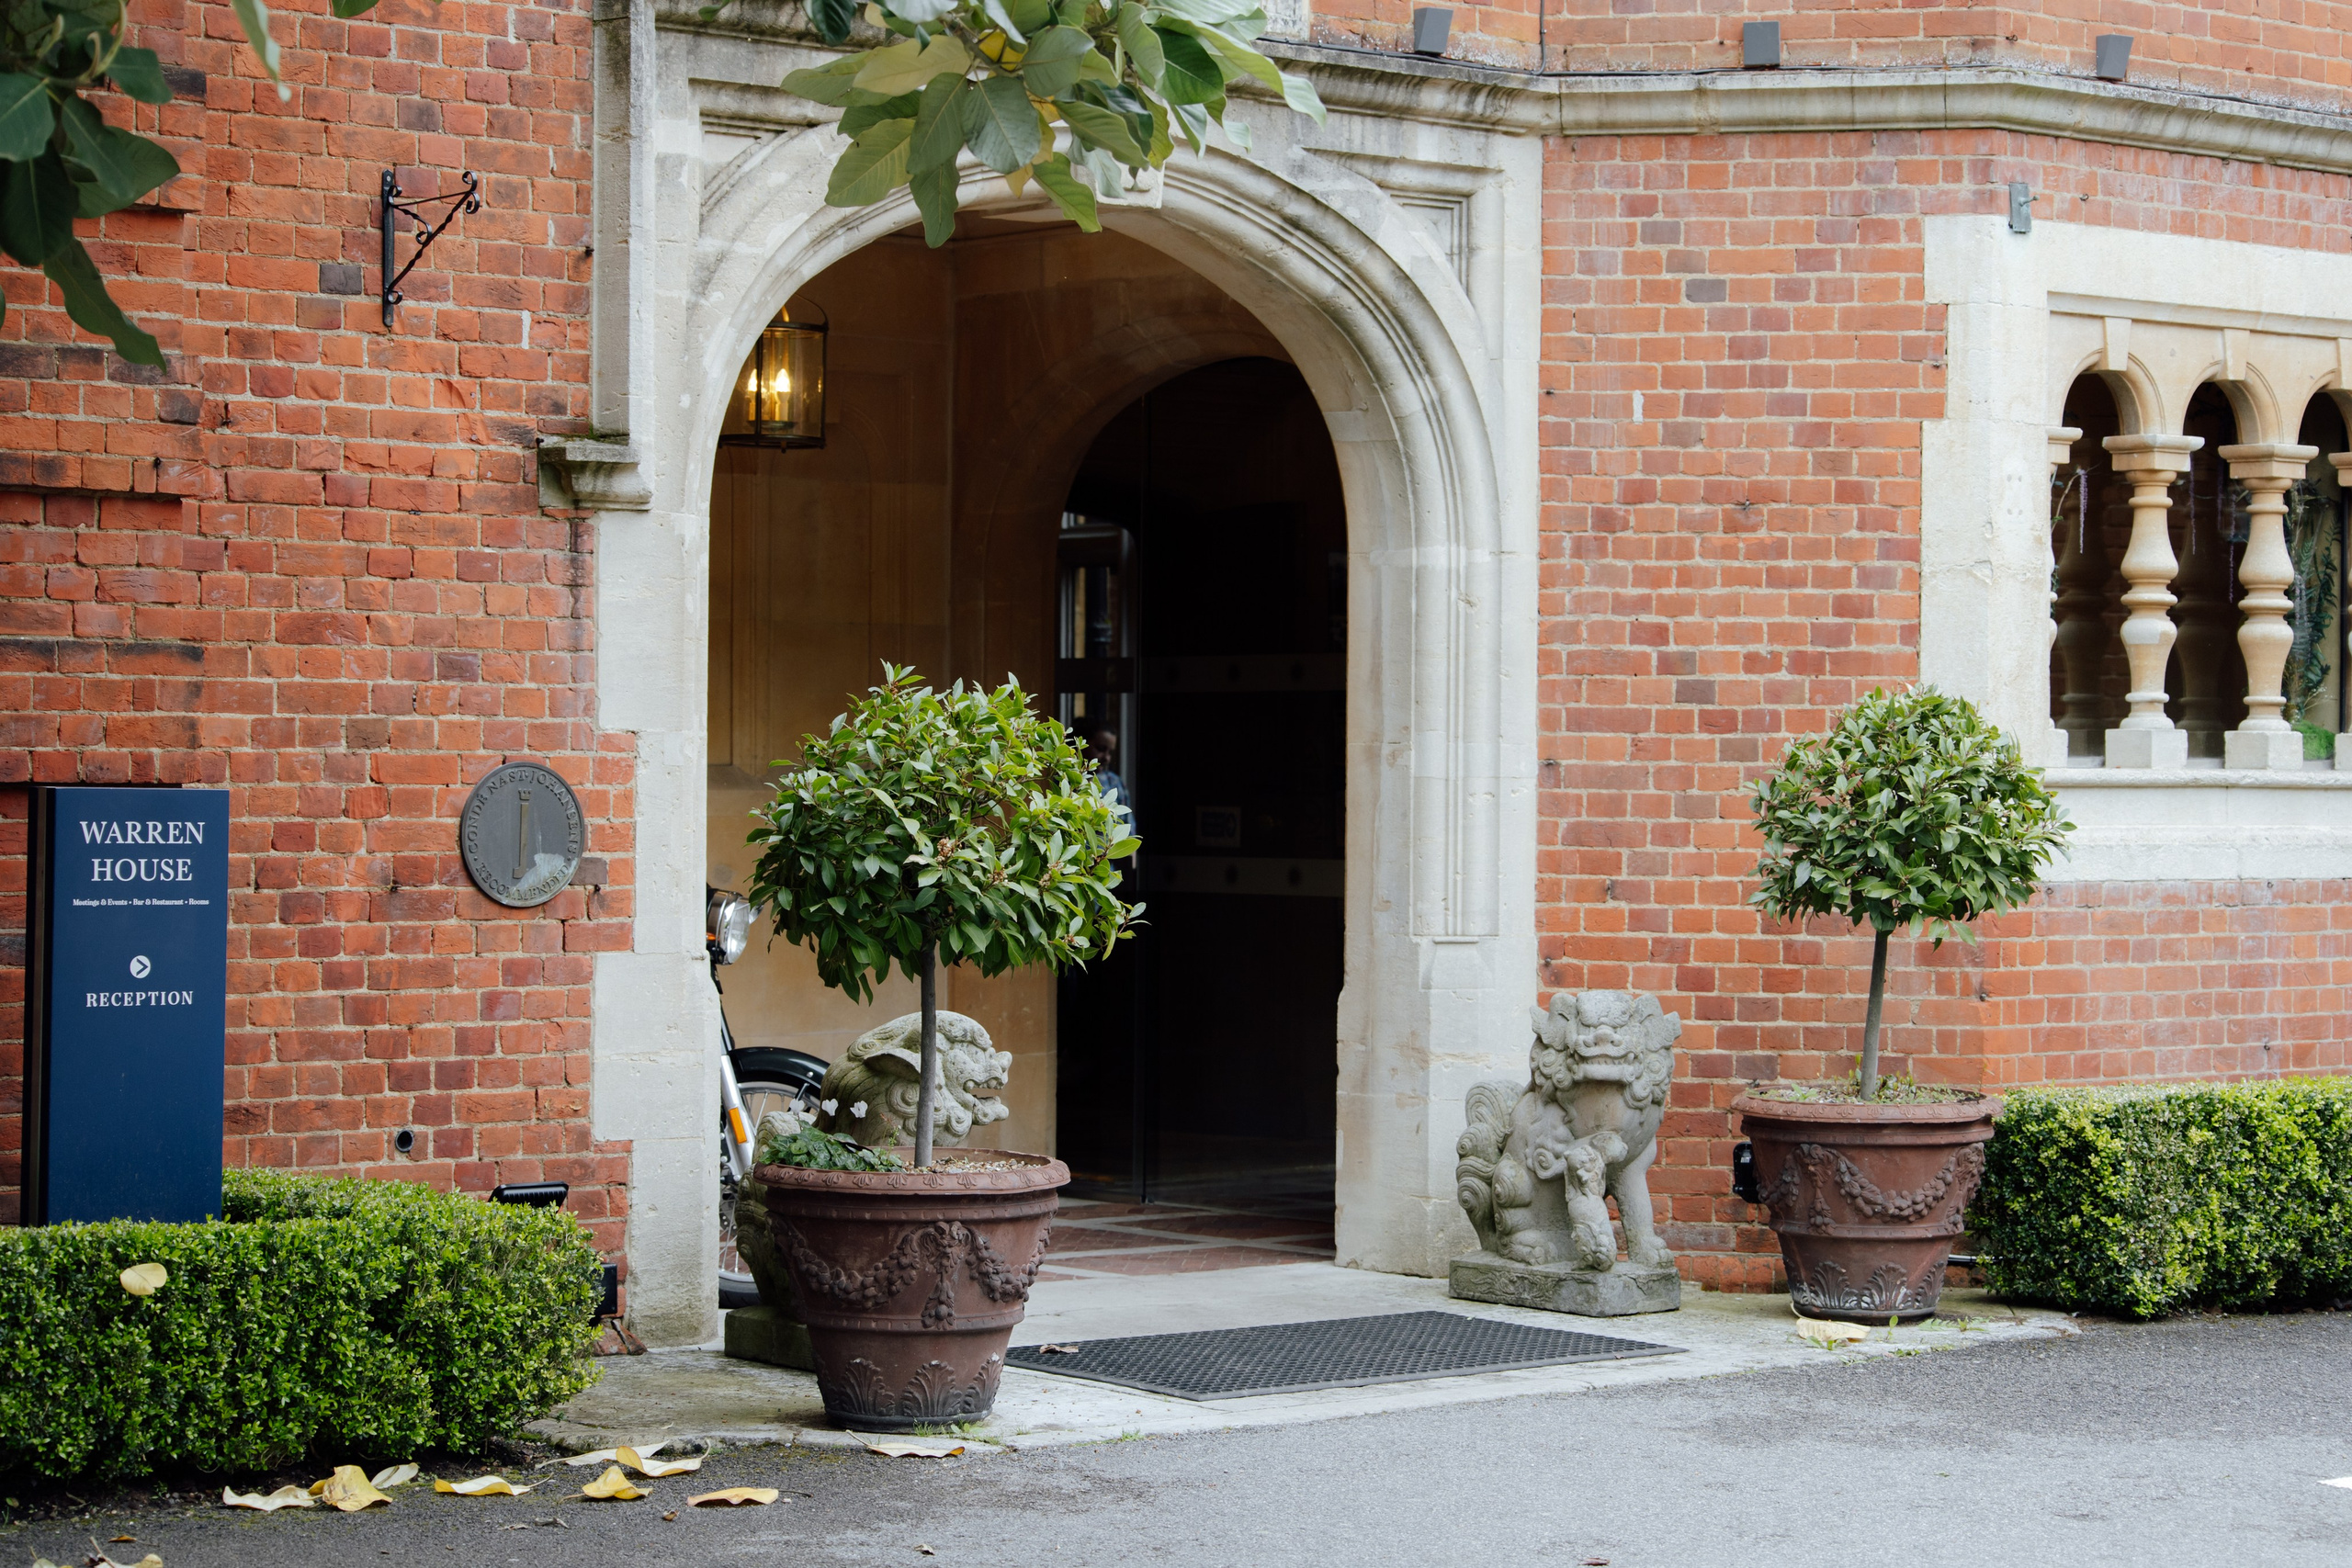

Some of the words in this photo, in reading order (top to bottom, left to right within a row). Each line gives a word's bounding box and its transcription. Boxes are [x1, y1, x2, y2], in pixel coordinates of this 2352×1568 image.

[79, 820, 206, 844] WARREN
[91, 858, 193, 882] HOUSE
[475, 862, 570, 901] RECOMMENDED
[73, 898, 100, 907] Meetings
[188, 897, 209, 906] Rooms
[85, 990, 194, 1008] RECEPTION
